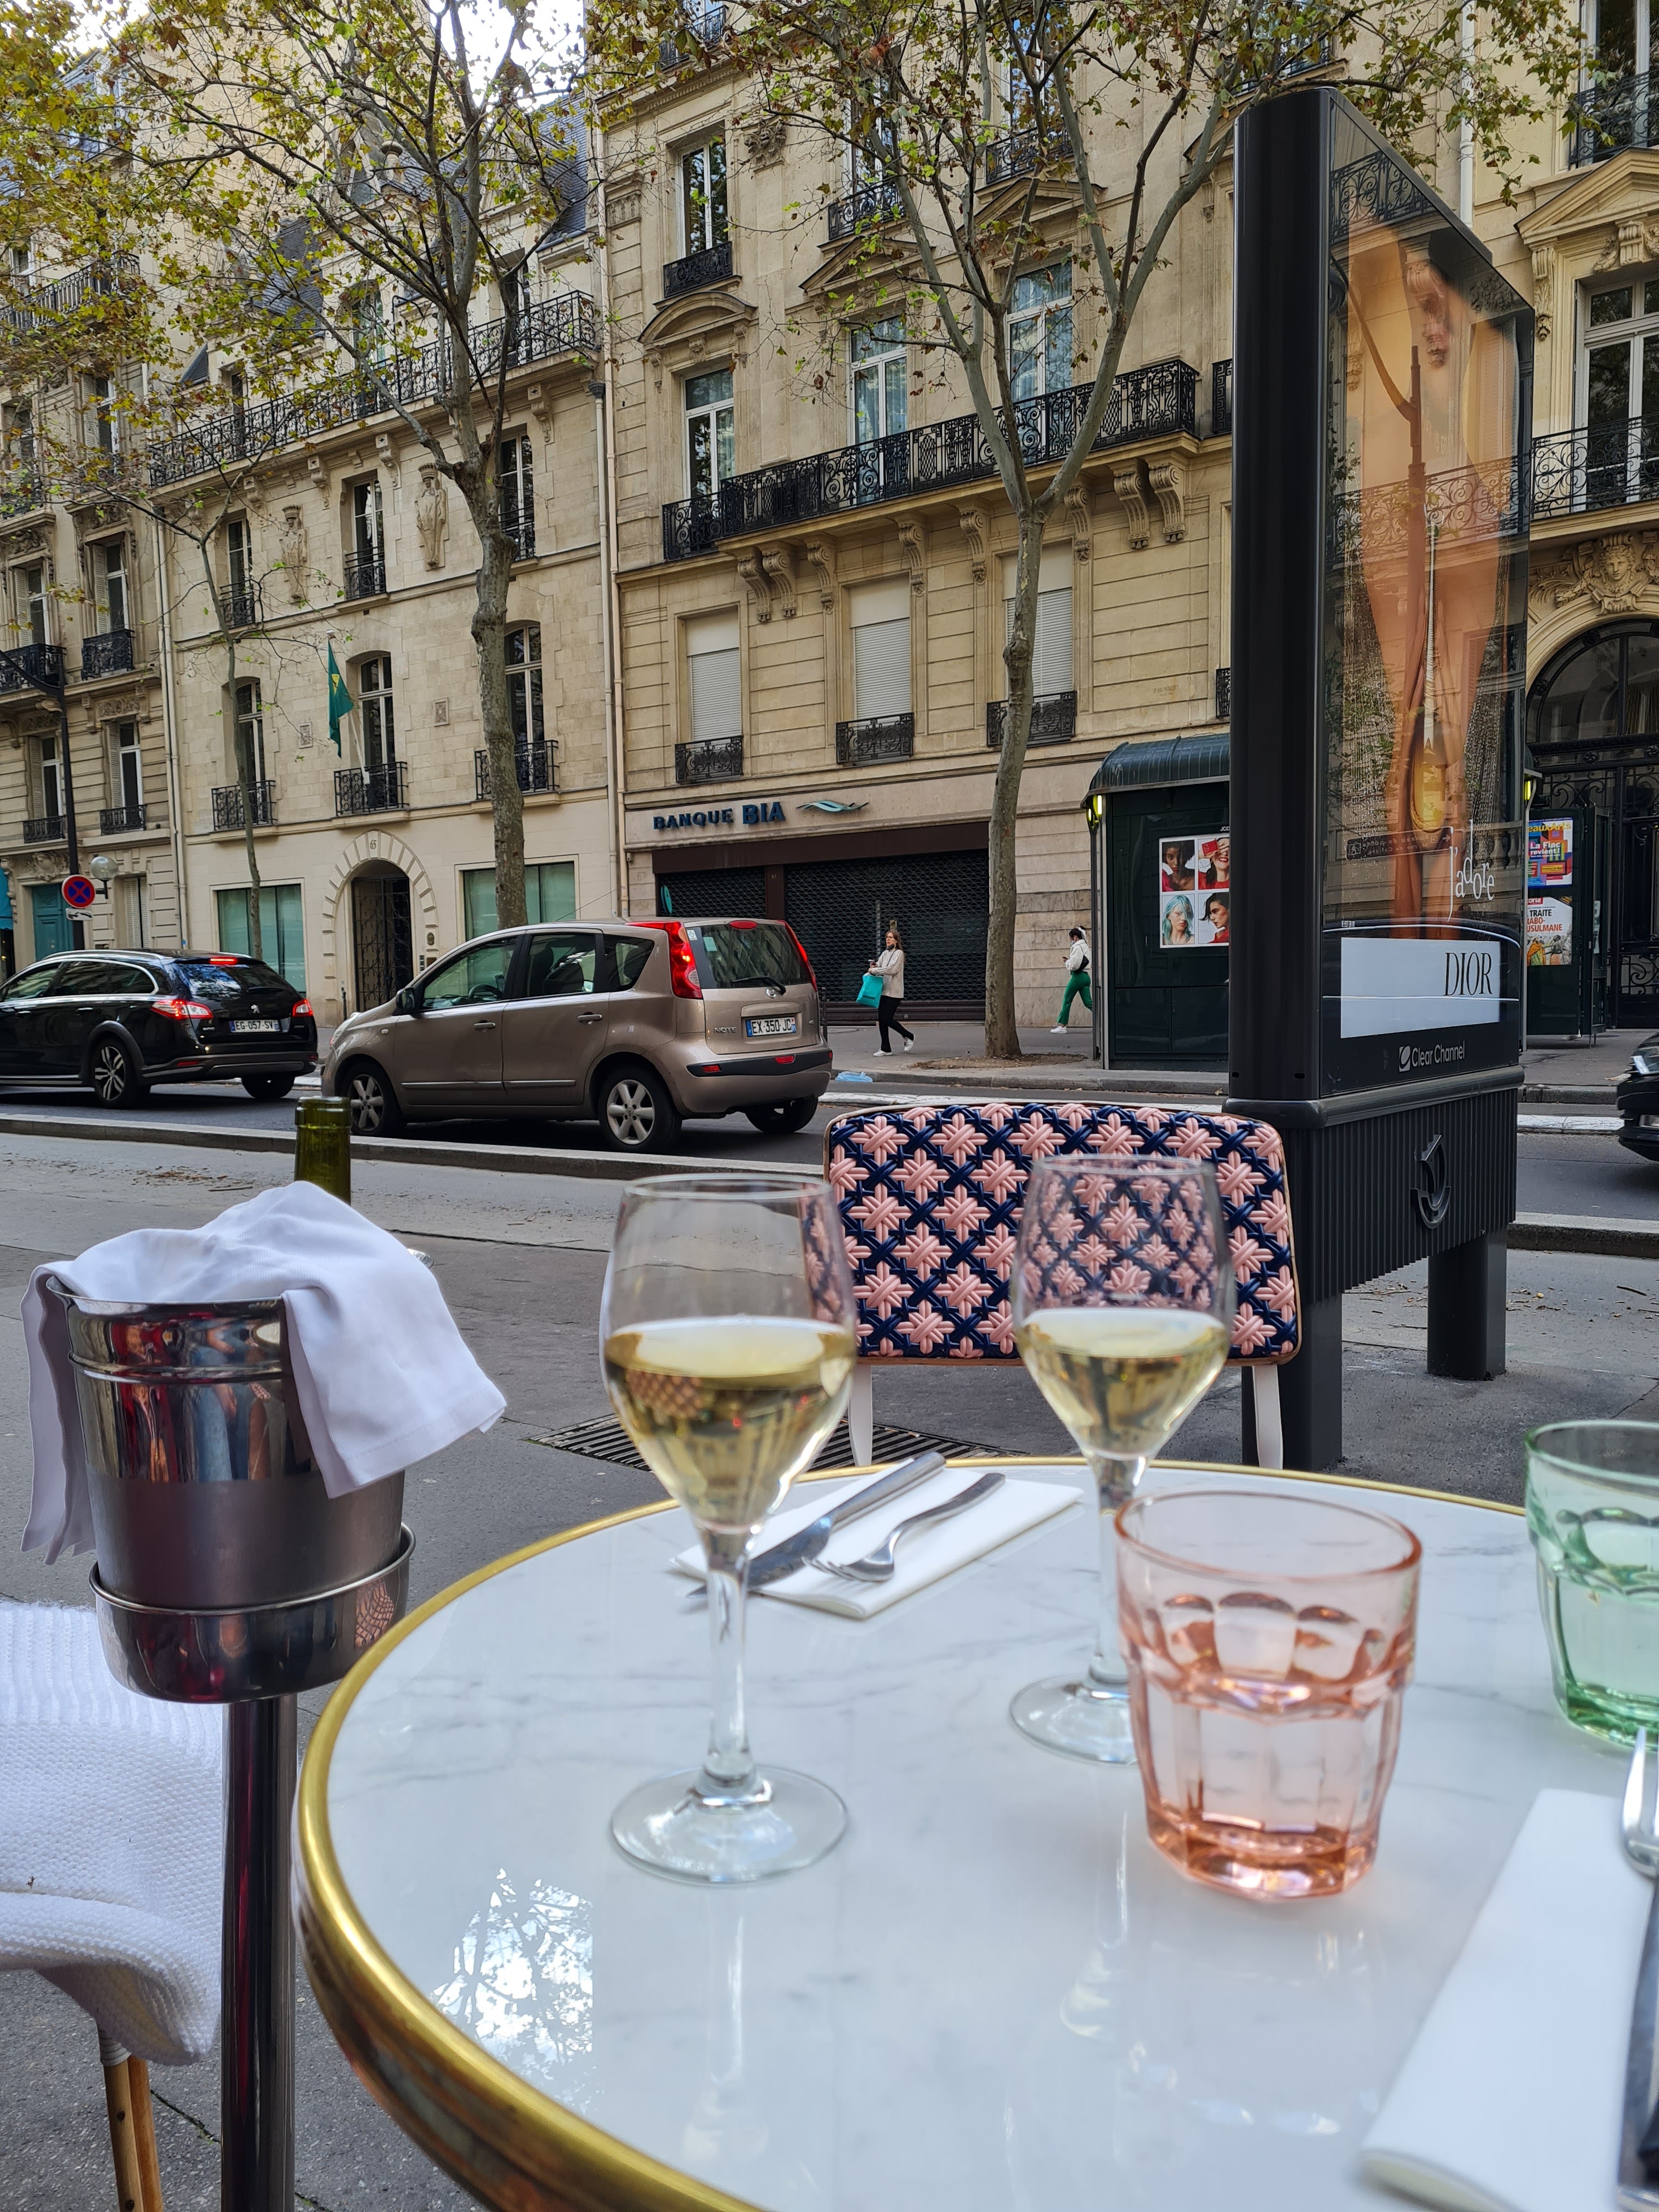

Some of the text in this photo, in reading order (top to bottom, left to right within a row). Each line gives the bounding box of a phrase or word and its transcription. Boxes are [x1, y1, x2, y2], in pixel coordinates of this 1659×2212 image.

[653, 802, 786, 830] BANQUE BIA
[1528, 822, 1571, 832] eauxArts
[370, 839, 377, 850] 65
[1530, 909, 1553, 918] TRAITE
[1527, 917, 1546, 926] RABO-
[1527, 923, 1563, 933] USULMANE
[1442, 952, 1493, 996] DIOR
[234, 1020, 273, 1030] EG-057-SV
[1412, 1040, 1465, 1068] Clear Channel
